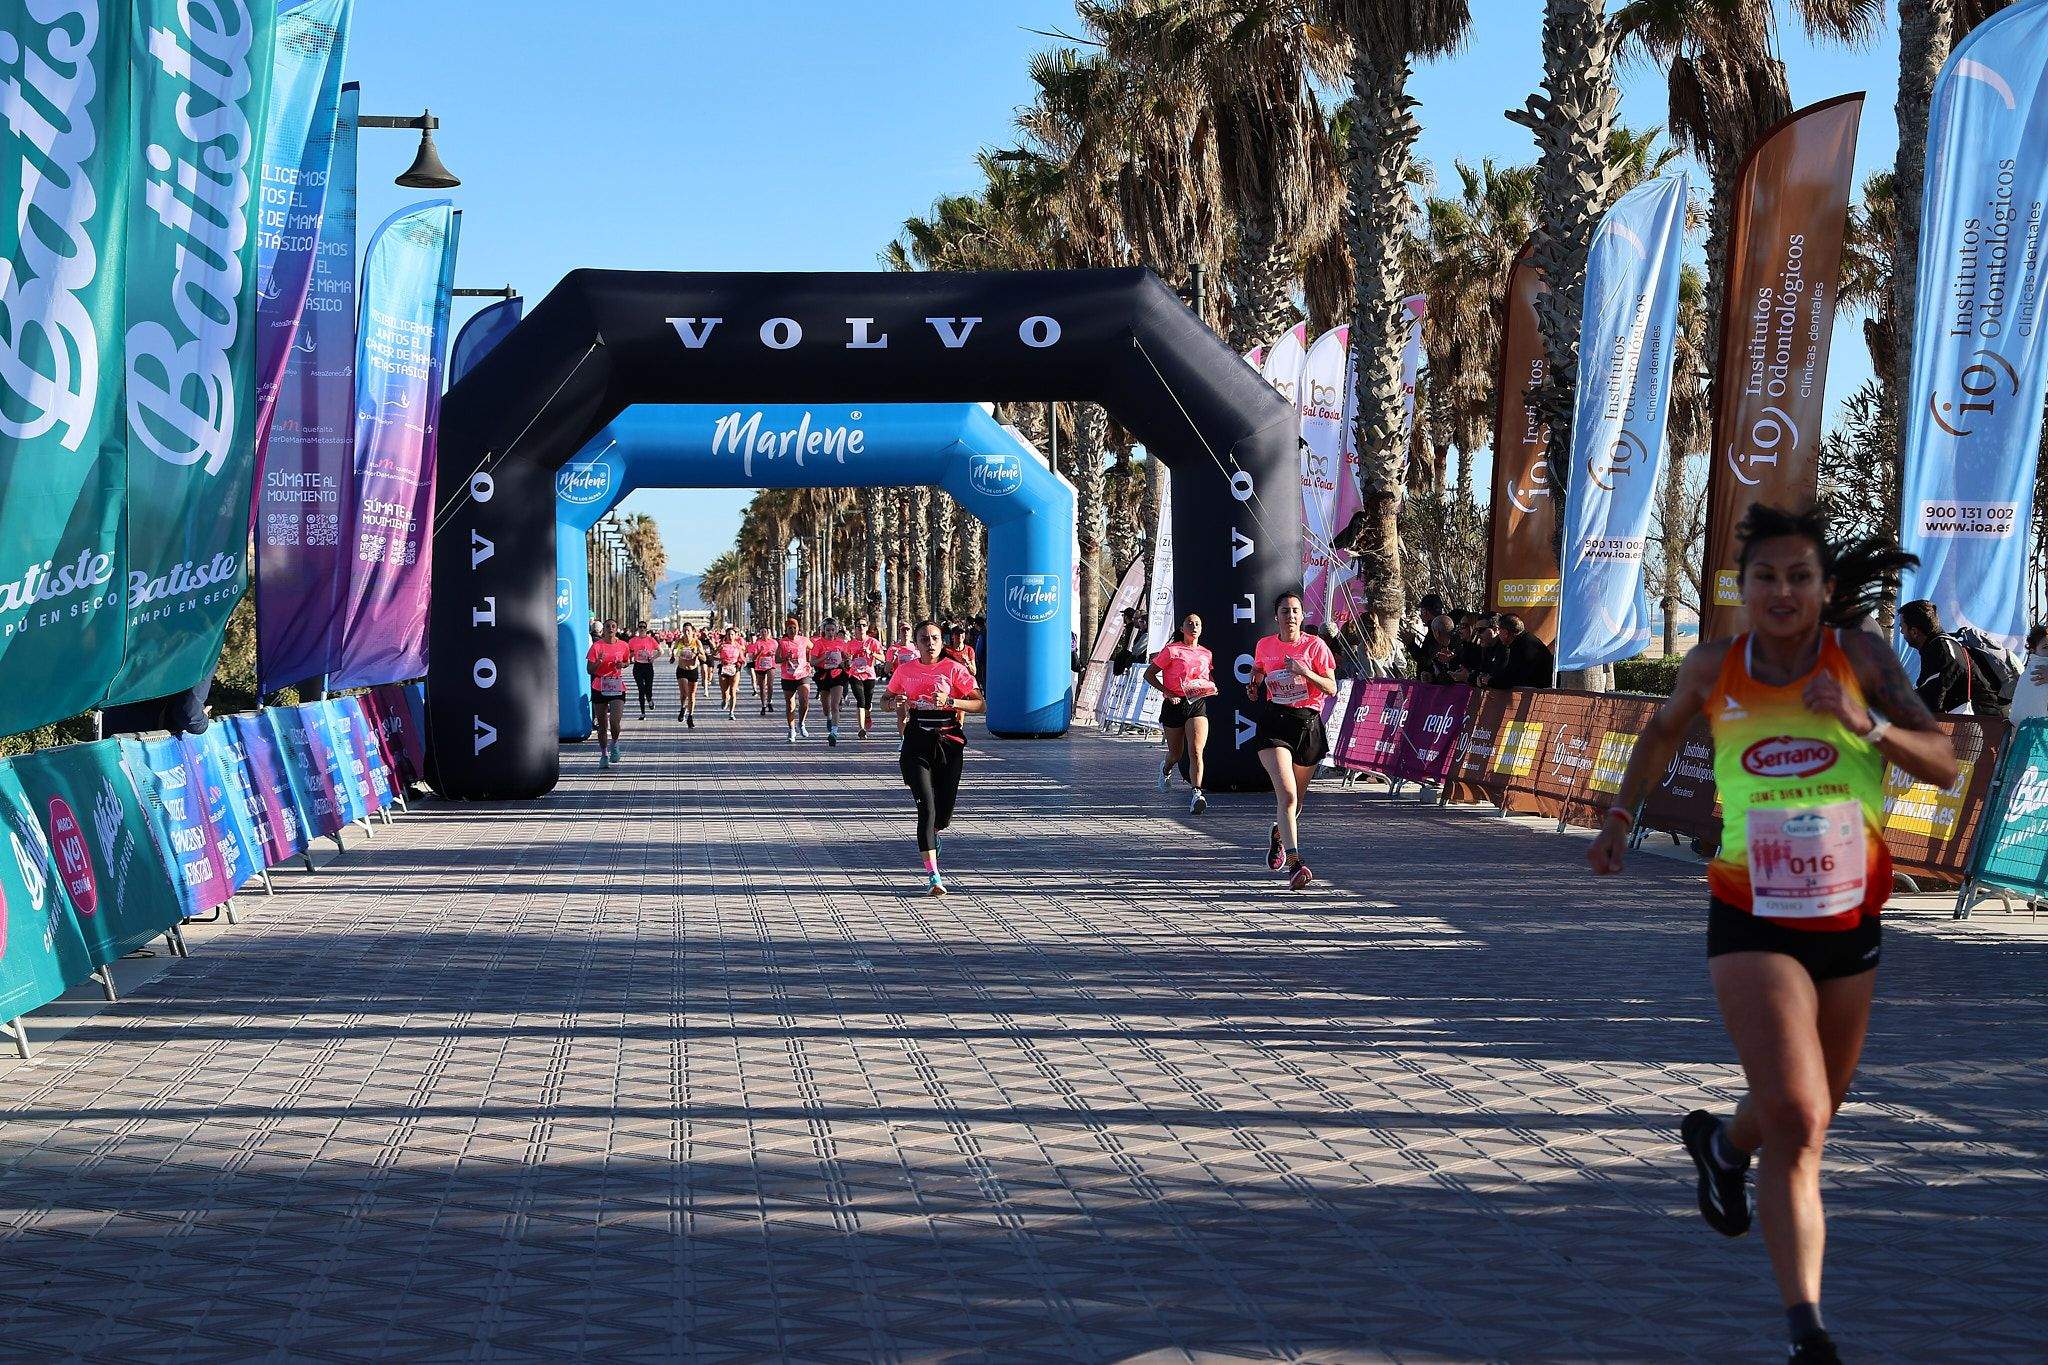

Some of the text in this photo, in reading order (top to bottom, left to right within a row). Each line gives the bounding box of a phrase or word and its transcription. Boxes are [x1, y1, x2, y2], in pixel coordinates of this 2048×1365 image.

[290, 191, 308, 208] EL
[0, 0, 99, 453] Batis
[267, 211, 286, 227] DE
[288, 214, 323, 230] MAMA
[125, 0, 253, 478] Batiste
[1979, 158, 2017, 339] Odontológicos
[317, 279, 352, 294] MAMA
[1950, 217, 1981, 339] Institutos
[2018, 201, 2041, 337] Clínicas dentales
[305, 294, 343, 311] ÁSICO
[1767, 234, 1804, 398] Odontológicos
[666, 315, 1061, 350] VOLVO
[1745, 286, 1774, 397] Institutos
[1800, 281, 1824, 398] Clínicas dentales
[1623, 294, 1647, 423] Odontológicos
[1647, 325, 1662, 422] Clínicas dentales
[1605, 335, 1625, 421] Institutos
[1302, 405, 1341, 420] Sal Costa
[1522, 359, 1544, 445] Institos
[711, 411, 865, 477] Marlene
[267, 468, 320, 487] SÚMATE
[323, 476, 337, 487] AL
[559, 471, 606, 492] Marlene
[973, 464, 1019, 485] Marlene
[267, 490, 337, 502] MOVIMIENTO
[363, 497, 406, 518] SÚMATE
[1925, 506, 2014, 520] 900 131 002
[362, 513, 417, 532] MOVIMIENTO
[1925, 520, 2010, 533] www.ioa.es
[1584, 550, 1642, 559] www.ioa.es
[1585, 539, 1645, 550] 900 131 002
[0, 548, 115, 613] atiste
[128, 551, 238, 610] Batiste
[1008, 585, 1057, 609] Marlene
[1503, 583, 1524, 593] 900
[40, 609, 60, 628] EN
[70, 592, 118, 617] SECO
[129, 584, 239, 628] AMPÚ EN SECO
[470, 471, 498, 756] VOLVO
[1230, 470, 1257, 750] VOLVO
[1379, 698, 1409, 736] renfe
[1422, 704, 1454, 744] renfe
[1751, 746, 1831, 770] Serrano
[1790, 854, 1835, 875] 016
